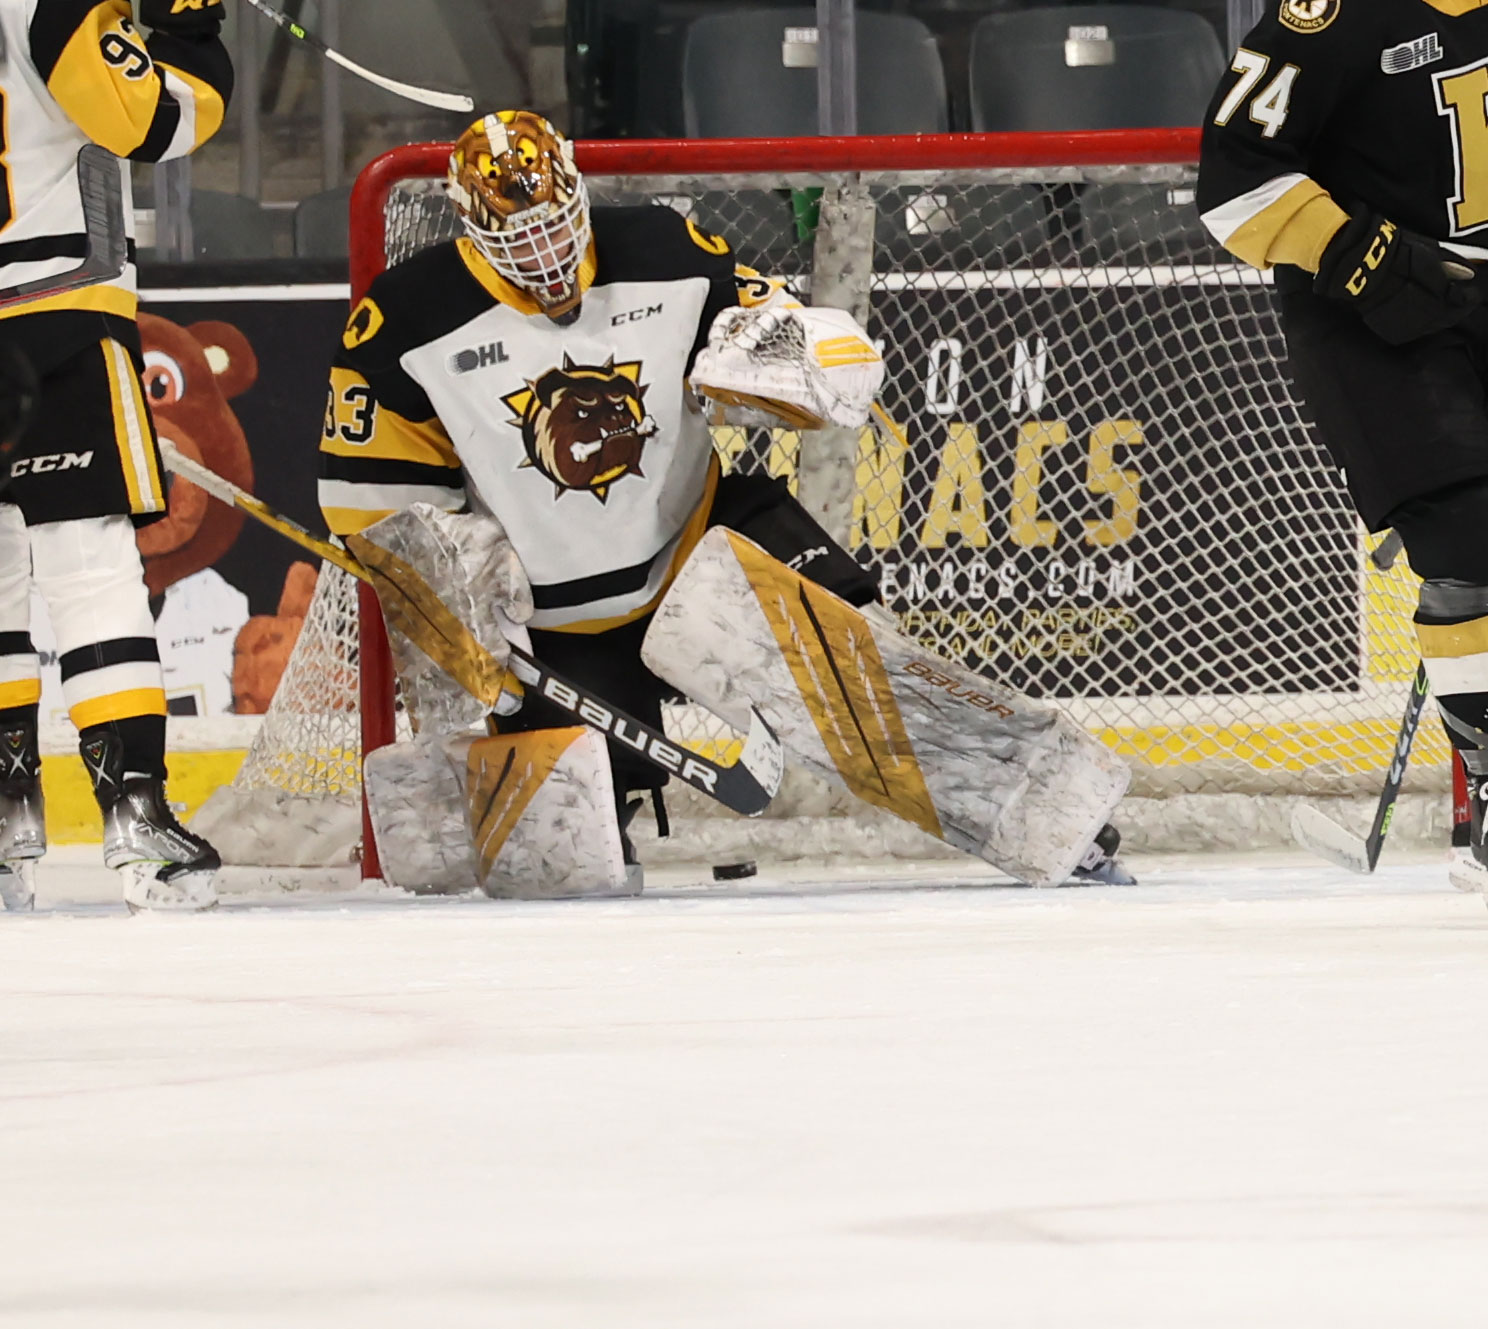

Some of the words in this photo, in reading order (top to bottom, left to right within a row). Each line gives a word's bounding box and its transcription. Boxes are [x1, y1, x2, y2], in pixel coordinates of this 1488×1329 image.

[1213, 47, 1303, 140] 74
[1345, 218, 1398, 297] CCM
[611, 303, 664, 328] CCM
[446, 339, 510, 375] OHL
[11, 450, 95, 478] CCM
